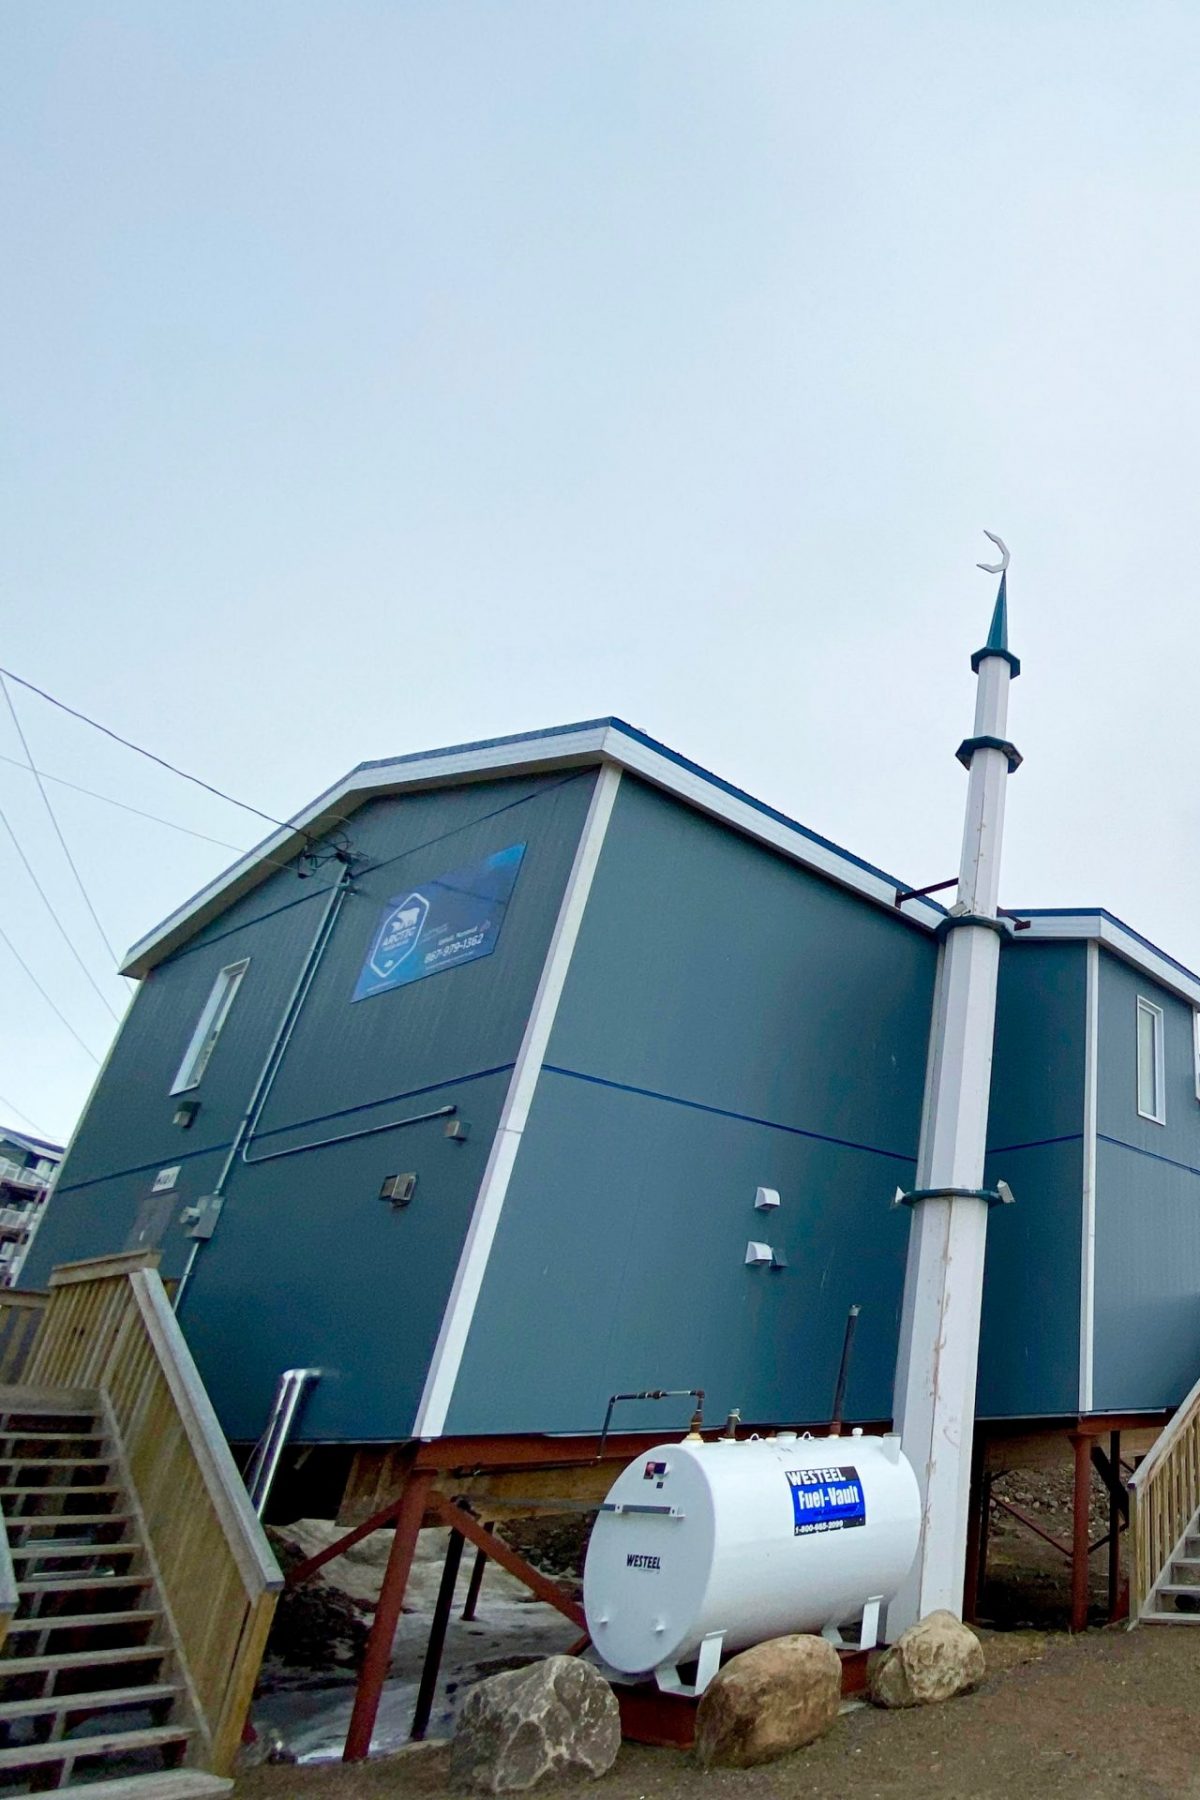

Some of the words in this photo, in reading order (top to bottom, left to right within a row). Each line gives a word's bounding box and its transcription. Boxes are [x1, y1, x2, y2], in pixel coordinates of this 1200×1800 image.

[786, 1467, 846, 1486] WESTEEL
[798, 1485, 860, 1510] Fuel-Vault
[626, 1554, 660, 1569] WESTEEL
